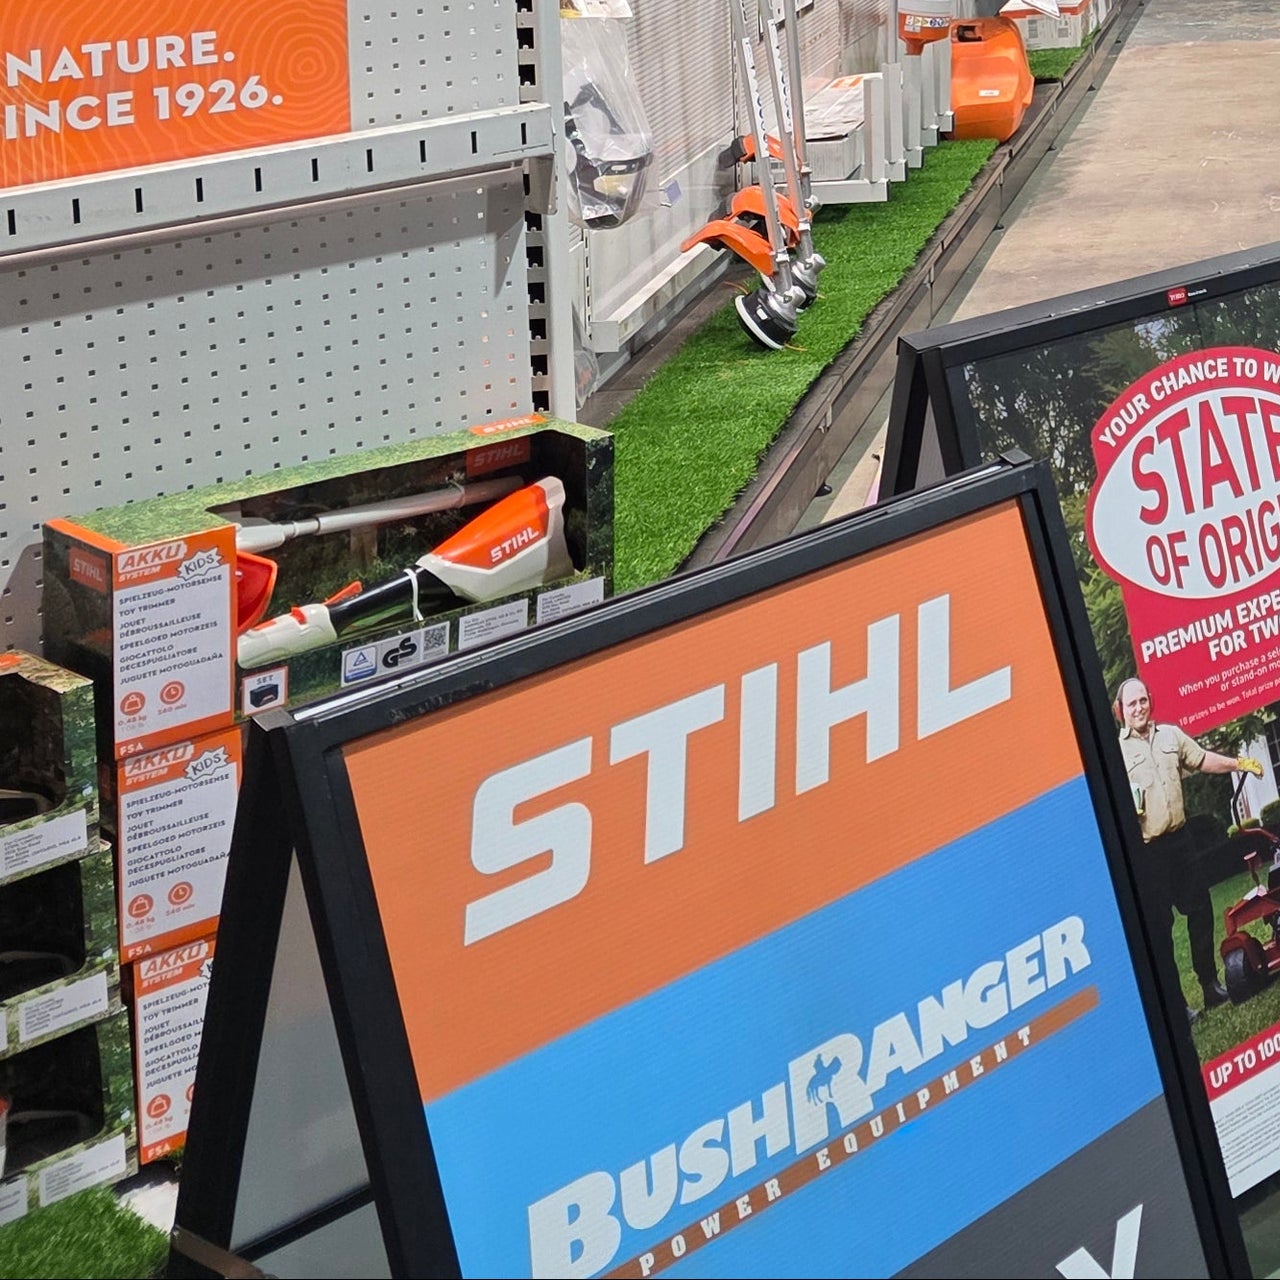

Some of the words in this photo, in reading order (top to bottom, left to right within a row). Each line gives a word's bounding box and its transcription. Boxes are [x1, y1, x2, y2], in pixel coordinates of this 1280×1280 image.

[5, 31, 235, 88] NATURE.
[153, 74, 284, 121] 1926.
[1098, 393, 1151, 448] YOUR
[1150, 357, 1228, 401] CHANCE
[1232, 357, 1258, 378] TO
[483, 417, 533, 433] STIHL
[473, 444, 523, 467] STIHL
[120, 543, 182, 571] AKKU
[490, 527, 539, 563] STIHL
[72, 558, 103, 582] STIHL
[184, 554, 215, 576] KIDS
[1146, 530, 1189, 589] OF
[119, 574, 223, 606] SPIELZEUG-MOTORSENSE
[119, 607, 137, 618] TOY
[138, 597, 176, 613] TRIMMER
[119, 618, 146, 630] JOUET
[1140, 608, 1233, 664] PREMIUM
[119, 634, 168, 651] SPEELGOED
[119, 644, 175, 664] GIOCATTOLO
[382, 637, 417, 668] GS
[1208, 630, 1247, 662] FOR
[119, 670, 158, 685] JUGUETE
[255, 673, 274, 686] SET
[1178, 678, 1204, 697] When
[1204, 673, 1221, 688] you
[1221, 658, 1260, 682] purchase
[1220, 681, 1231, 693] or
[1231, 666, 1268, 689] stand-on
[1187, 708, 1209, 725] prizes
[1217, 701, 1226, 711] be
[1241, 686, 1257, 702] Total
[1257, 679, 1275, 697] prize
[119, 743, 144, 756] FSA
[128, 744, 190, 775] AKKU
[190, 753, 222, 776] KIDS
[463, 593, 1013, 946] STIHL
[126, 773, 230, 808] SPIELZEUG-MOTORSENSE
[126, 810, 143, 821] TOY
[145, 798, 184, 815] TRIMMER
[126, 819, 154, 833] JOUET
[127, 845, 183, 866] GIOCATTOLO
[127, 870, 166, 888] JUGUETE
[128, 944, 152, 959] FSA
[145, 945, 200, 977] AKKU
[143, 1012, 159, 1023] TOY
[161, 997, 200, 1016] TRIMMER
[143, 1020, 171, 1036] JOUET
[144, 1044, 199, 1068] GIOCATTOLO
[1210, 1062, 1233, 1088] UP
[1235, 1049, 1257, 1074] TO
[145, 1070, 183, 1090] JUGUETE
[528, 913, 1092, 1280] BUSHRANGER
[147, 1141, 171, 1159] FSA
[638, 1178, 783, 1276] POWER
[816, 1025, 1035, 1172] EQUIPMENT
